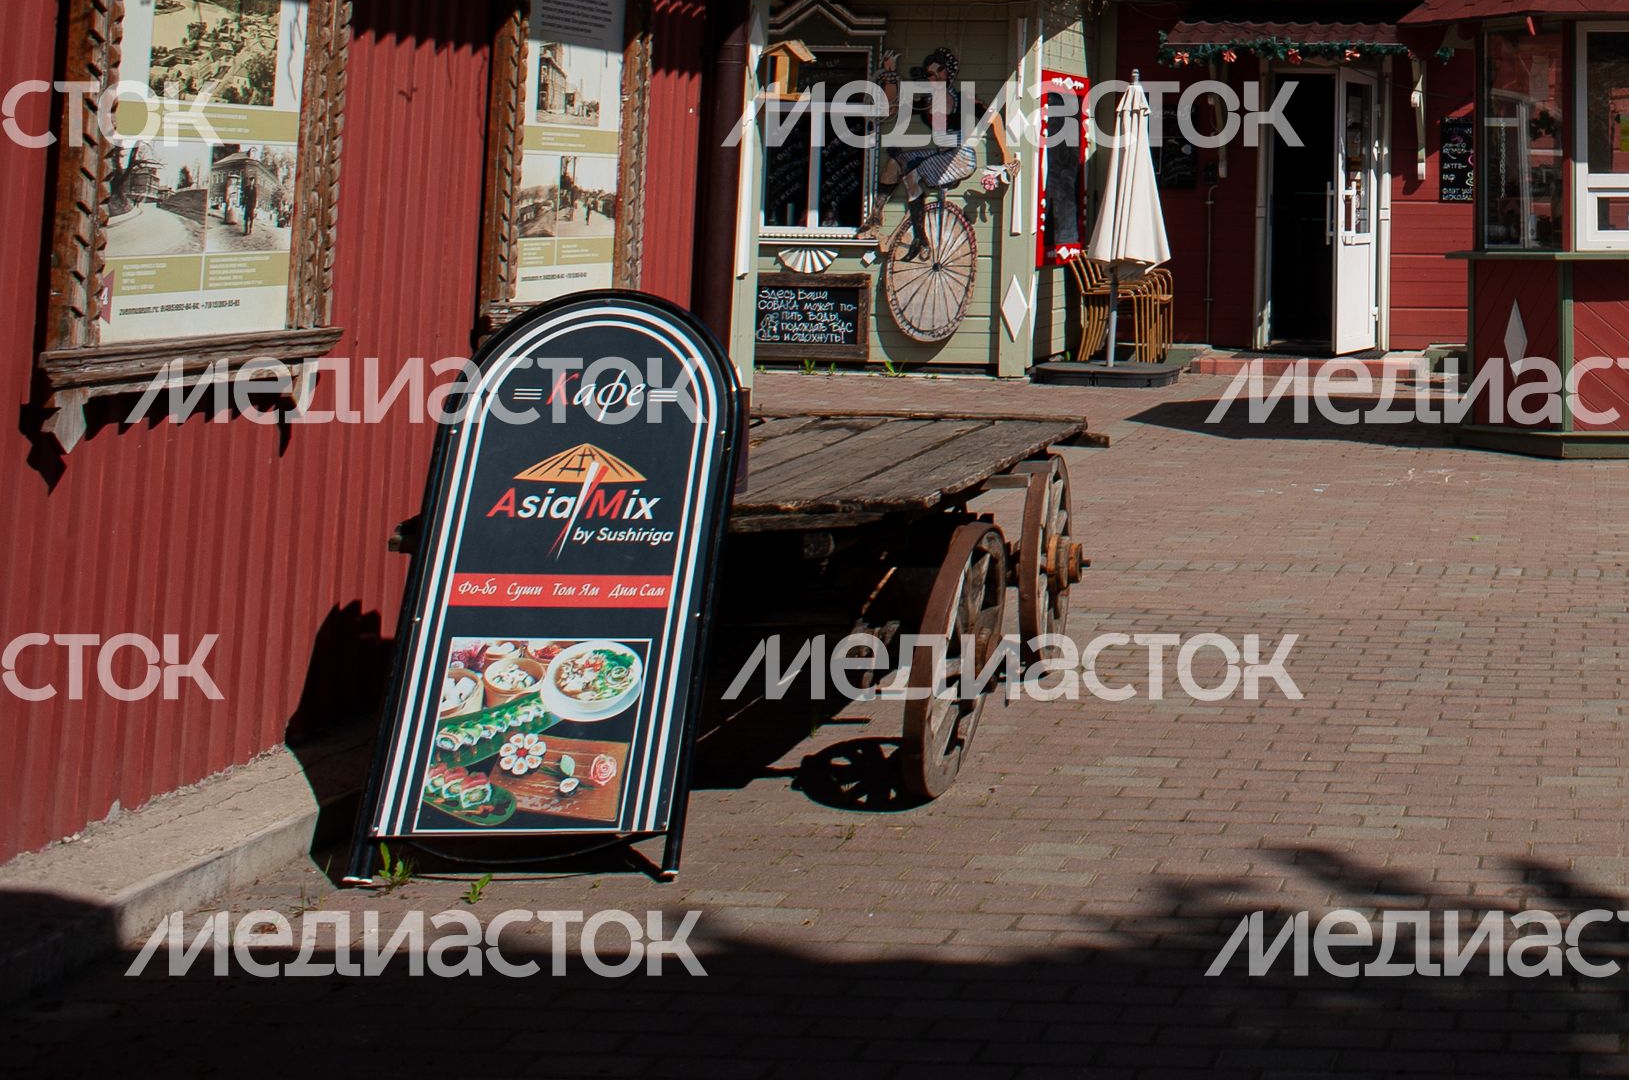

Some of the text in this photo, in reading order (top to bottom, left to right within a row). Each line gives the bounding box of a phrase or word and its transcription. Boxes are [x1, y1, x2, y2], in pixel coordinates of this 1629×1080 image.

[546, 370, 646, 421] Кафе
[486, 487, 661, 520] Asia Mix
[573, 527, 674, 546] by Sushiriga
[458, 578, 665, 601] Фо-бо Суши Том Ям Дим Сам
